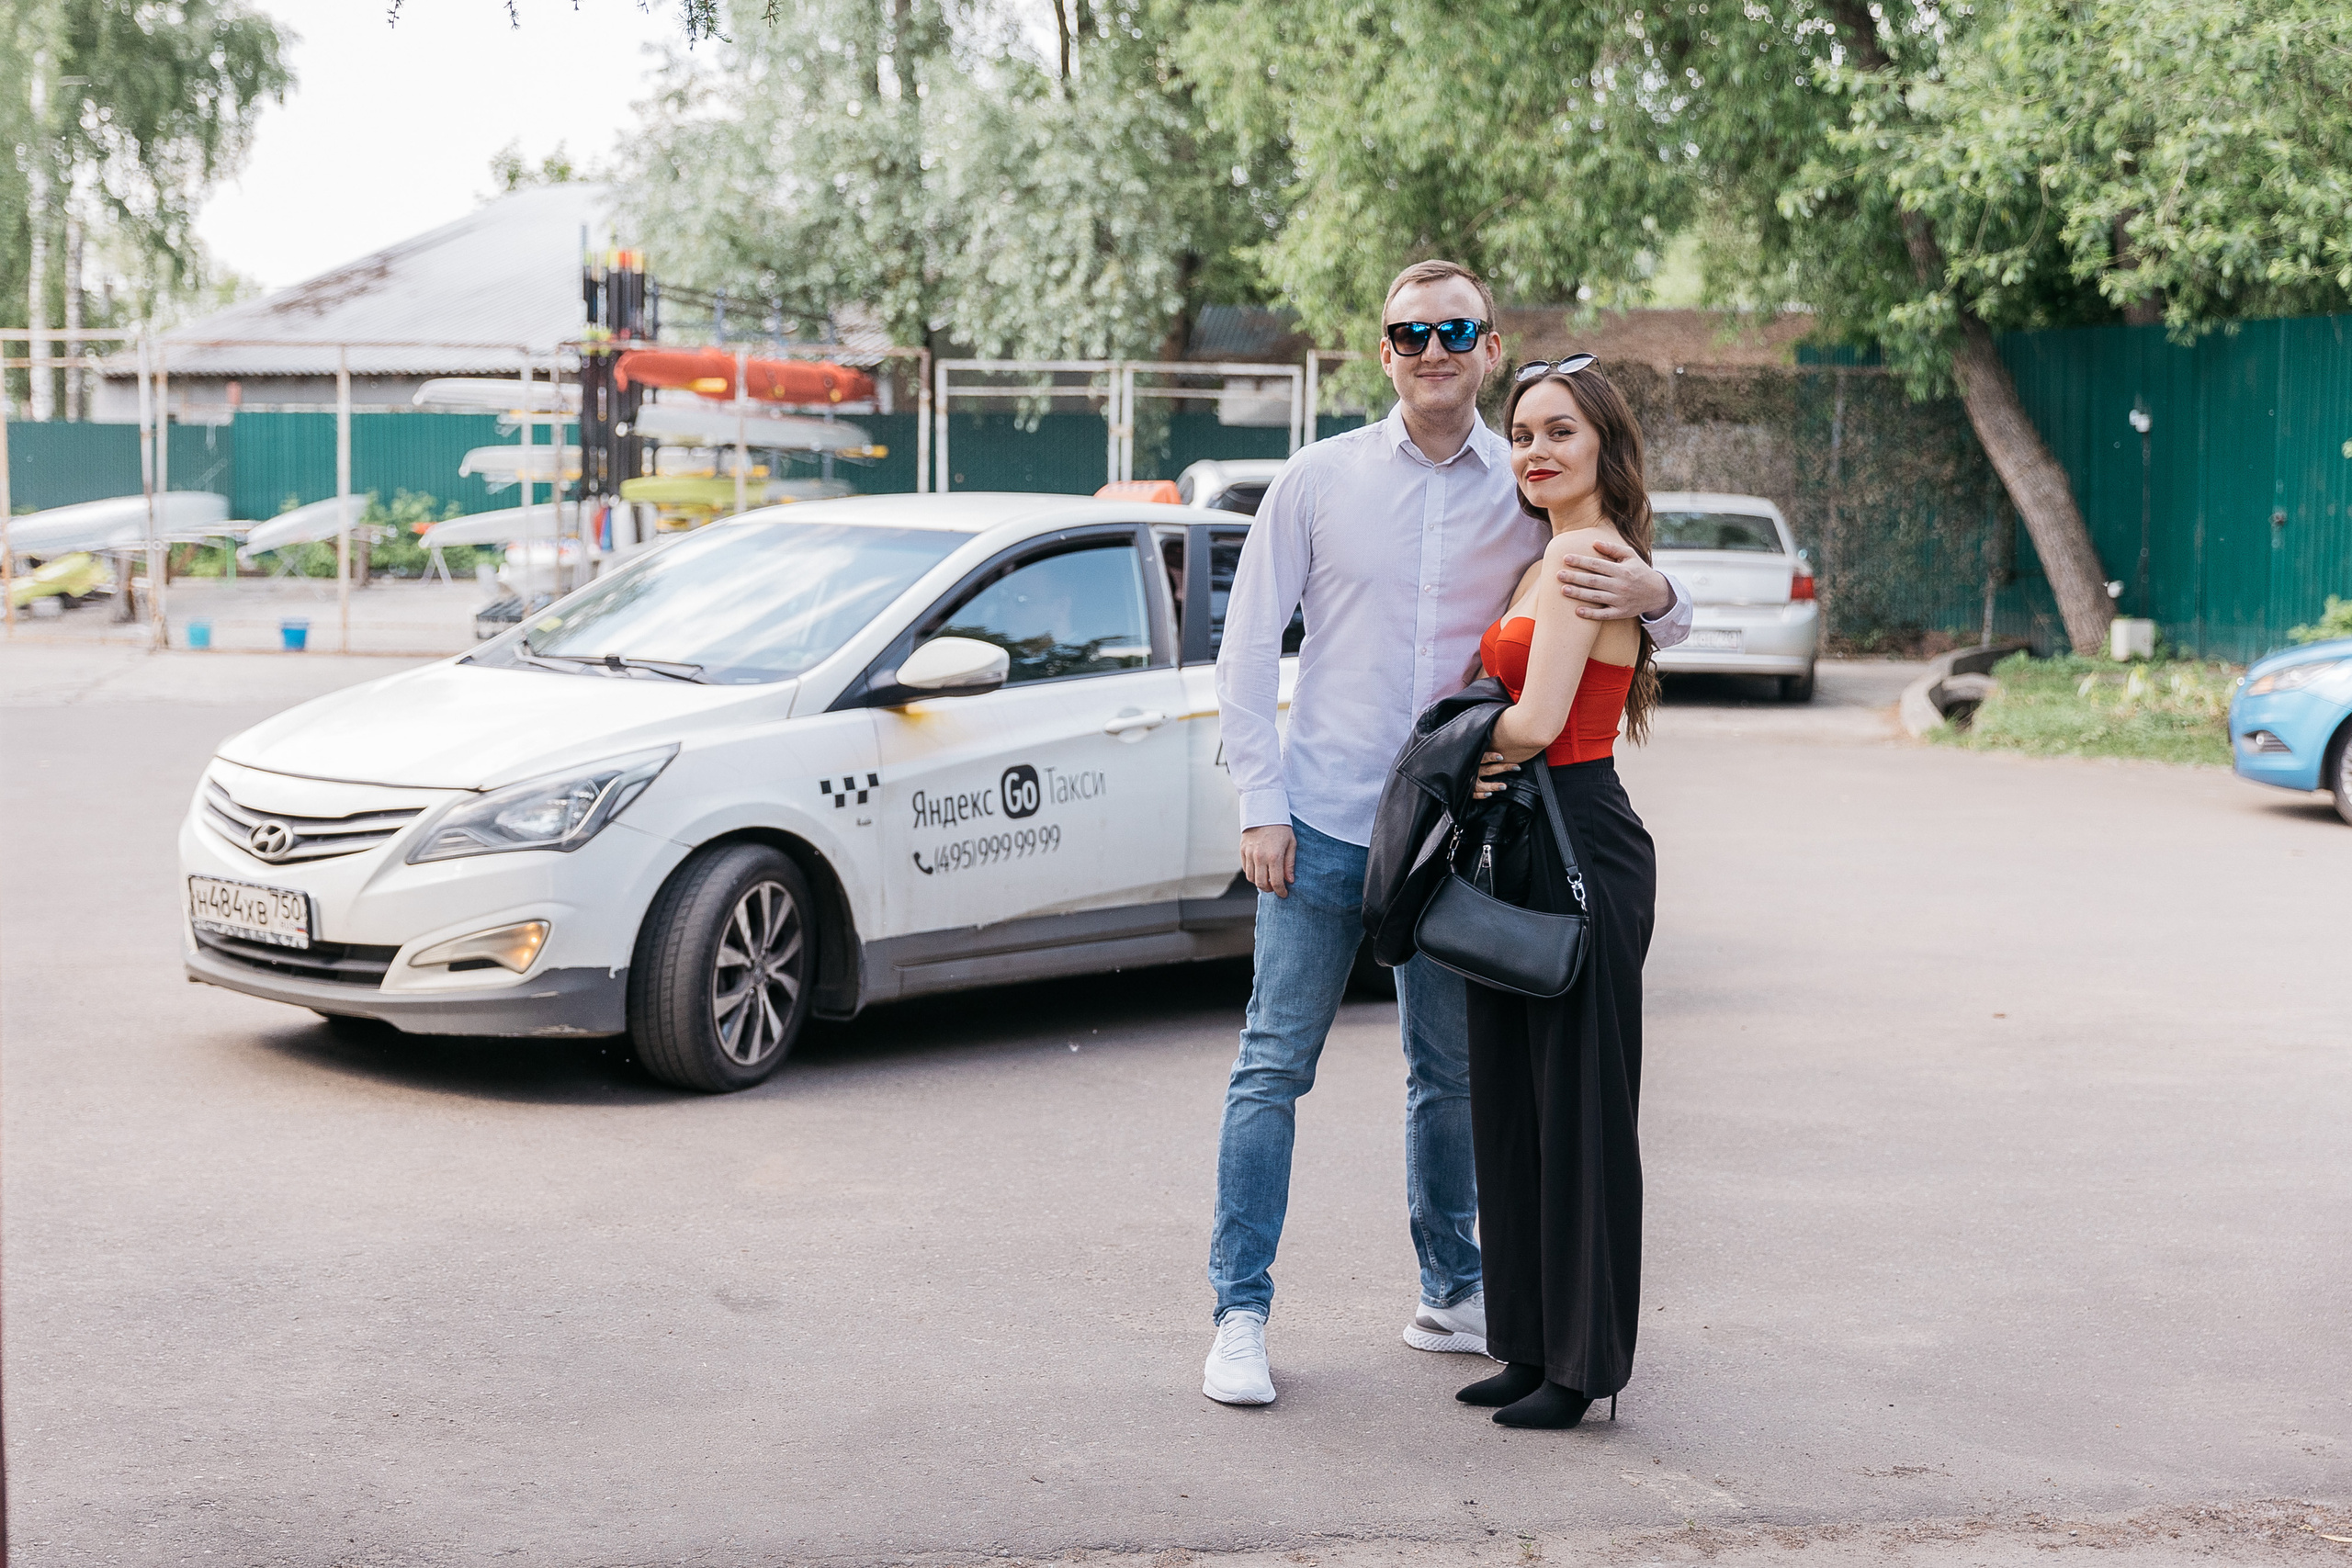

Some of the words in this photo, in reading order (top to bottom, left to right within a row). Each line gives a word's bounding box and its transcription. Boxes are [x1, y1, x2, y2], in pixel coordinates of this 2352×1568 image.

[912, 789, 993, 828] Яндекс
[1004, 772, 1038, 814] Go
[1044, 766, 1106, 805] Такси
[270, 893, 300, 919] 750
